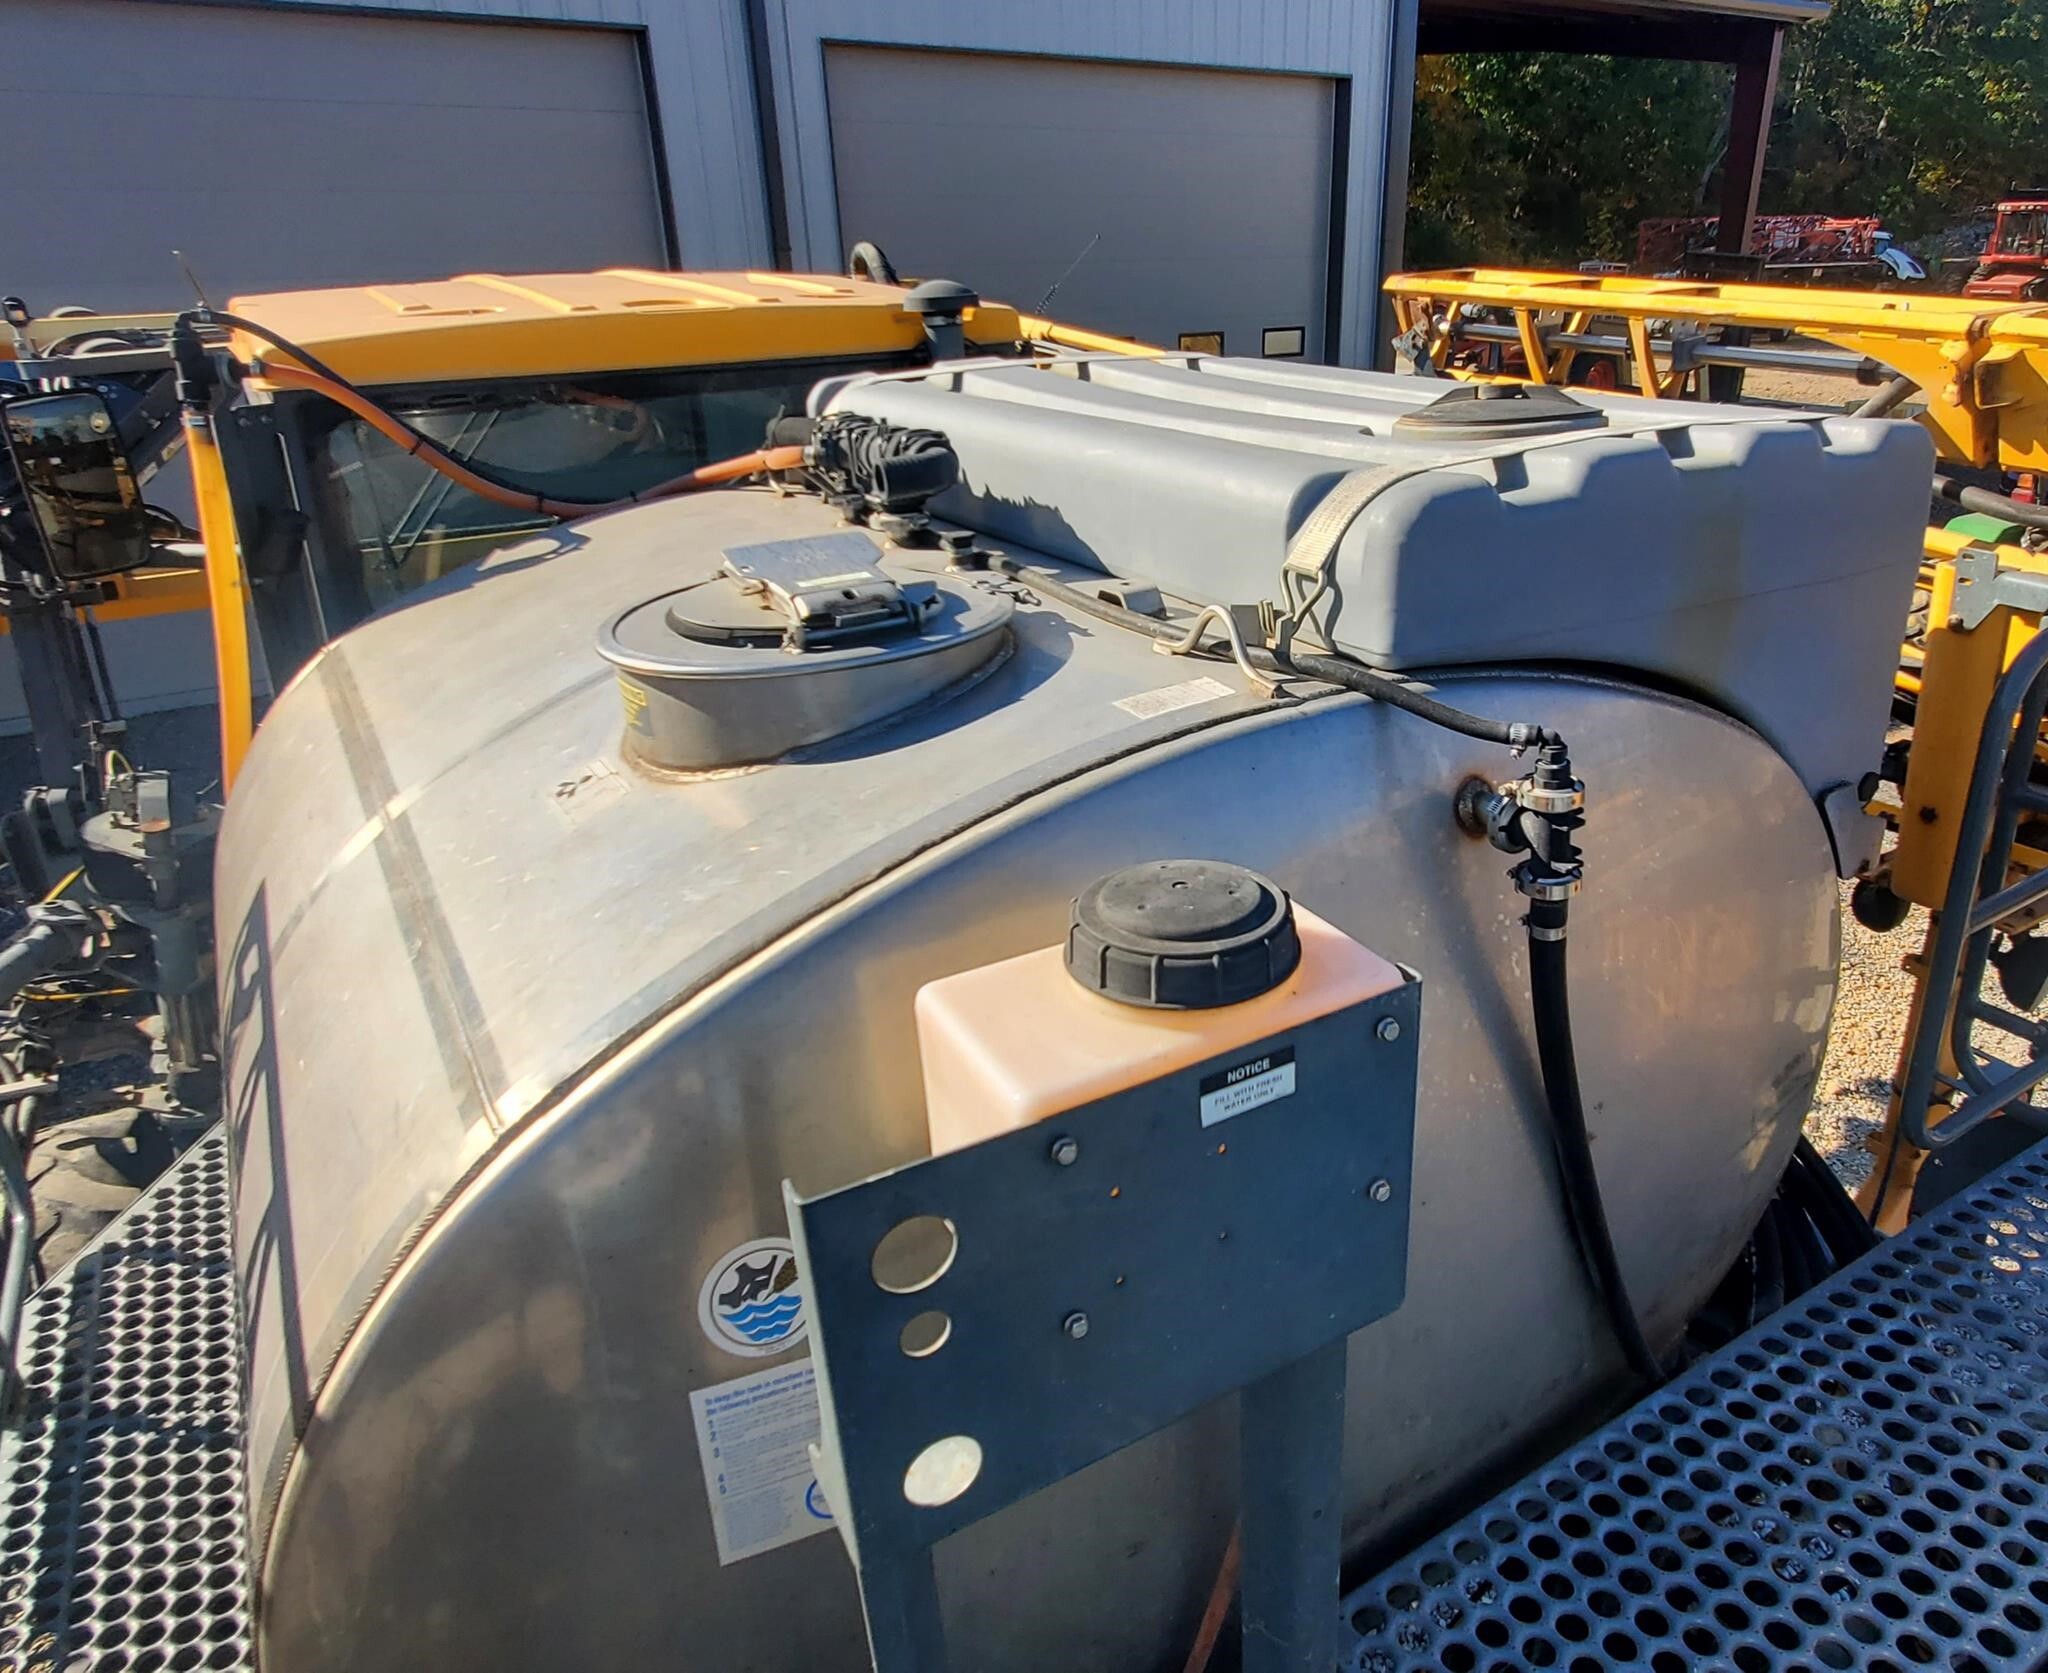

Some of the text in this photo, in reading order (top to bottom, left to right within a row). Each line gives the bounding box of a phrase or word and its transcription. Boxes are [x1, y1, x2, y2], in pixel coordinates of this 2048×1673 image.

[1227, 1058, 1270, 1083] NOTICE
[1233, 1085, 1255, 1098] WITH
[1224, 1096, 1252, 1111] WATER
